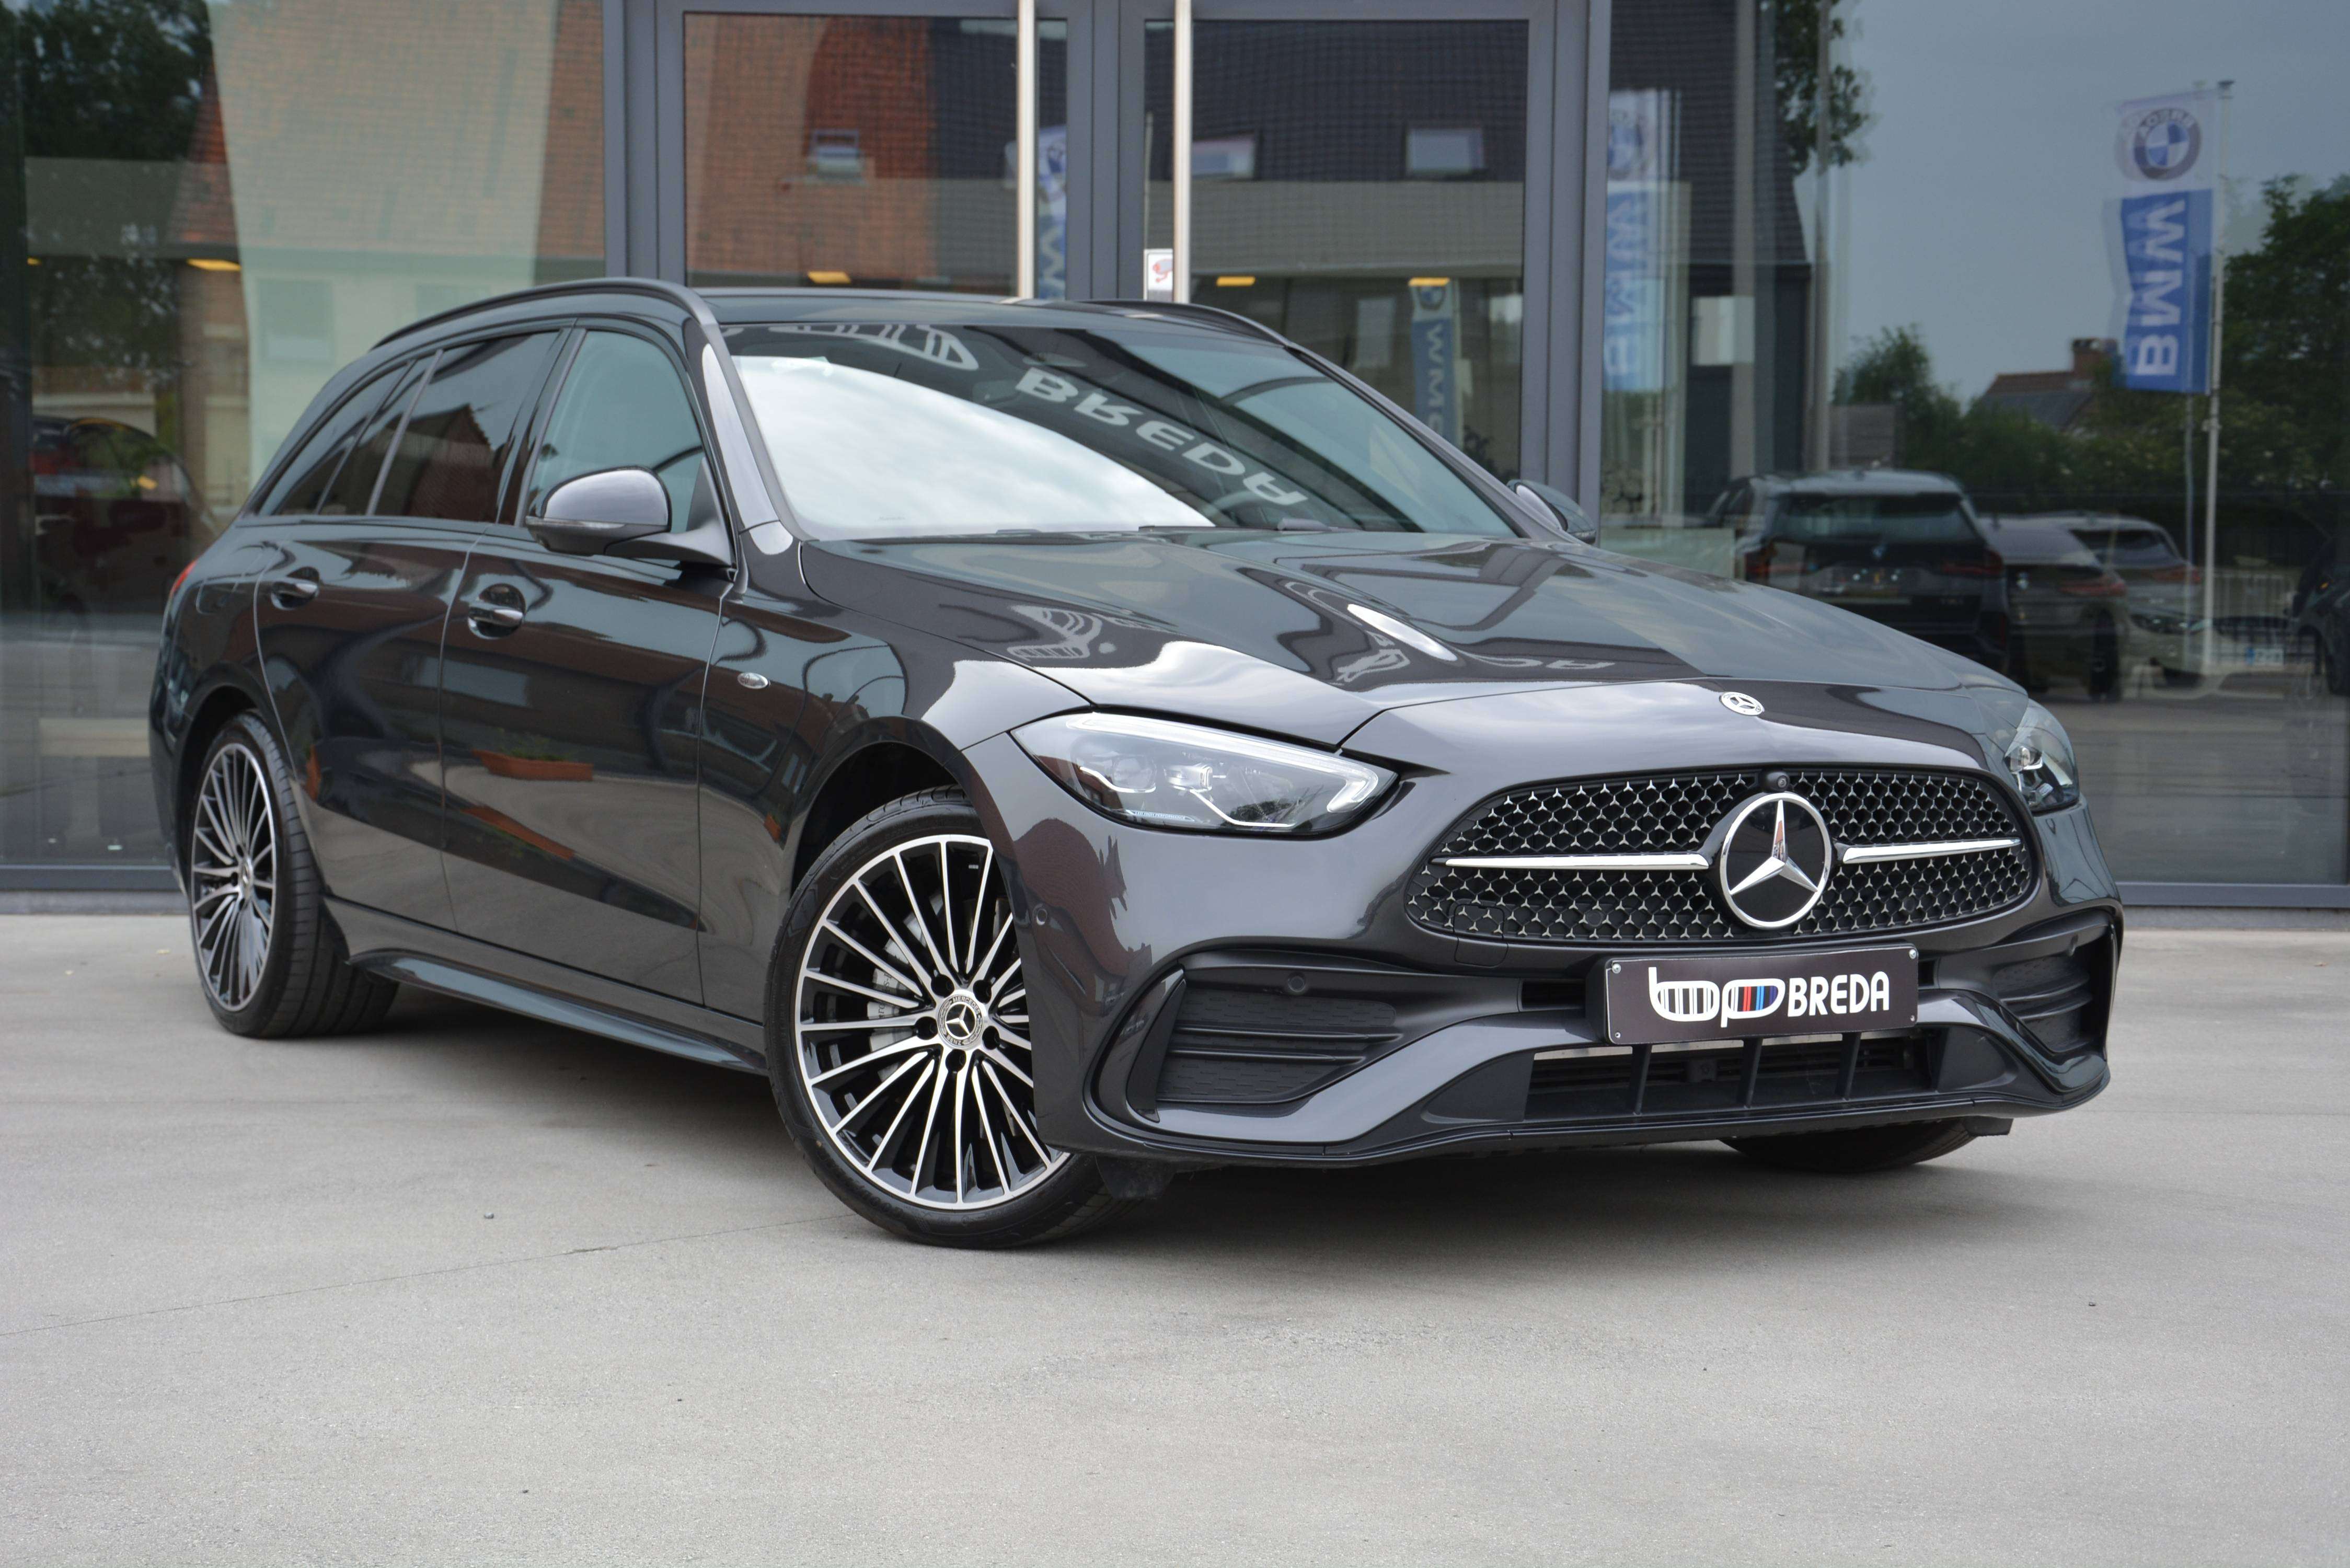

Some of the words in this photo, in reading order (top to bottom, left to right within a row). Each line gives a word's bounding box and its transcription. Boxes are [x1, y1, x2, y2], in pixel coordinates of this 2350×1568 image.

[1788, 971, 1890, 1017] BREDA
[952, 996, 981, 1014] MERCEDES
[946, 1034, 962, 1045] BENZ
